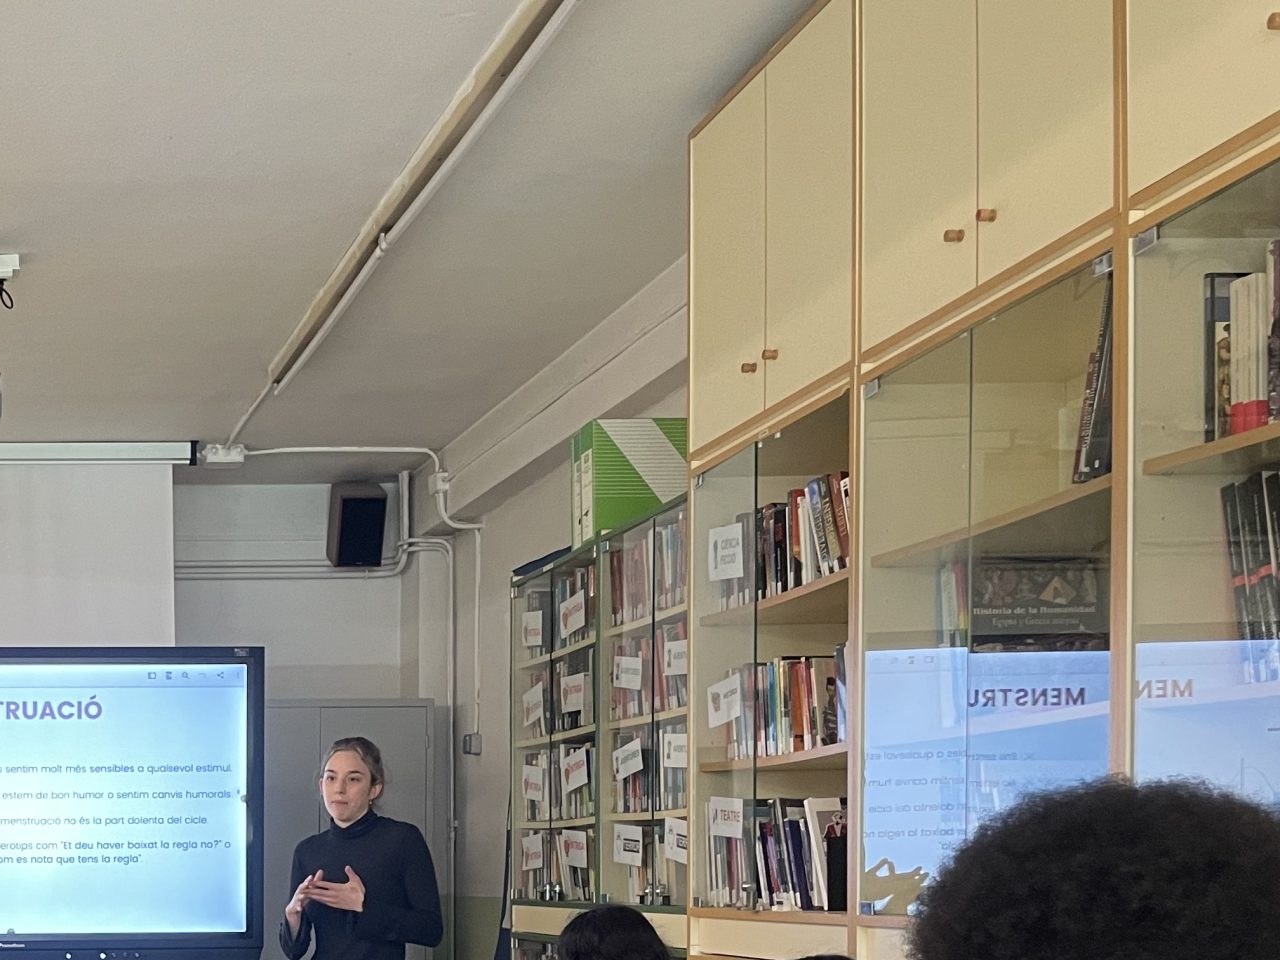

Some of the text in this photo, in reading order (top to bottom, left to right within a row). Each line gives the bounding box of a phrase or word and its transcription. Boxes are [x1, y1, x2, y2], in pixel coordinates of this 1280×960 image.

[1014, 606, 1027, 614] de
[1028, 605, 1038, 614] la
[6, 764, 38, 773] sentim
[41, 764, 62, 773] molt
[66, 764, 86, 773] més
[90, 764, 134, 773] sensibles
[137, 765, 144, 773] a
[147, 764, 193, 774] qualsevol
[196, 764, 232, 772] estimul.
[36, 791, 48, 799] de
[51, 790, 69, 799] bon
[73, 790, 104, 799] humor
[117, 790, 149, 799] sentim
[152, 790, 183, 799] canvis
[0, 816, 61, 825] menstruació
[79, 816, 90, 825] és
[93, 816, 102, 825] la
[105, 817, 124, 826] part
[128, 816, 164, 825] dolenta
[167, 816, 182, 825] del
[185, 816, 209, 824] cicle.
[720, 809, 741, 823] TEATRE
[36, 842, 57, 850] com
[61, 841, 72, 849] "Et
[75, 841, 93, 849] deu
[97, 841, 124, 849] haver
[127, 840, 157, 849] baixat
[161, 840, 170, 849] la
[173, 840, 197, 851] regla
[16, 856, 28, 864] es
[31, 855, 53, 864] nota
[56, 856, 75, 866] que
[78, 855, 98, 863] tens
[102, 855, 110, 863] la
